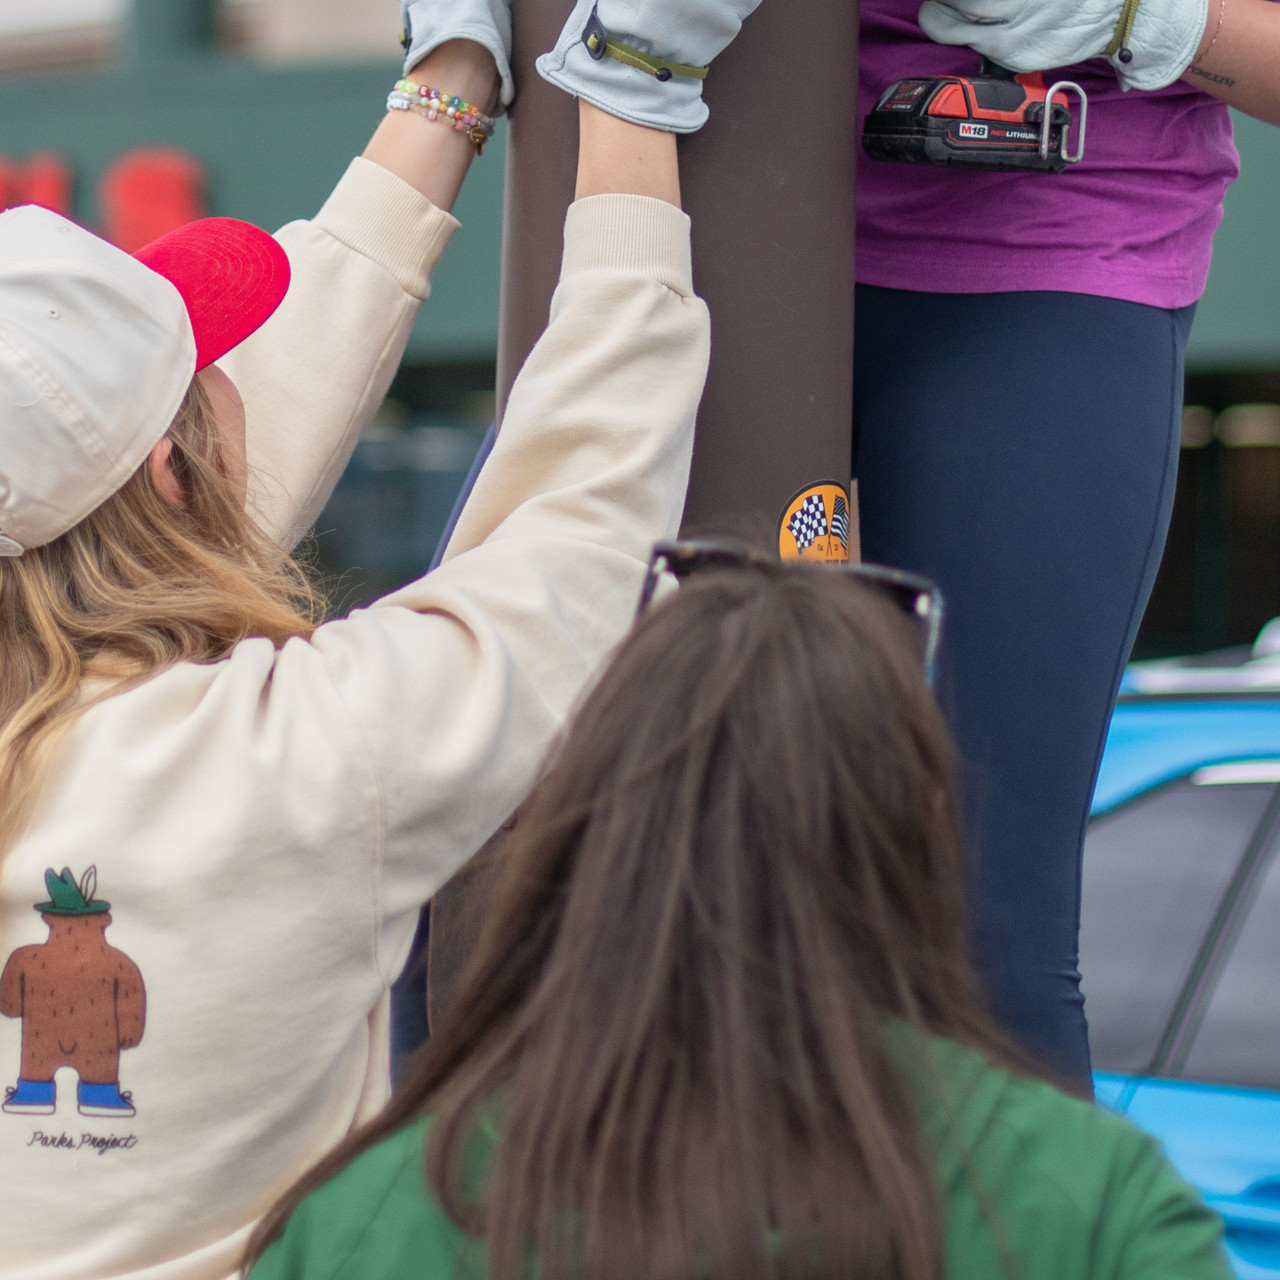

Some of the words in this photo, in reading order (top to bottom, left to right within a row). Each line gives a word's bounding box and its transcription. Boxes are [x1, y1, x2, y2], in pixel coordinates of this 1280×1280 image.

[961, 125, 986, 136] M18
[26, 1131, 76, 1149] Parks
[76, 1132, 138, 1156] Project
